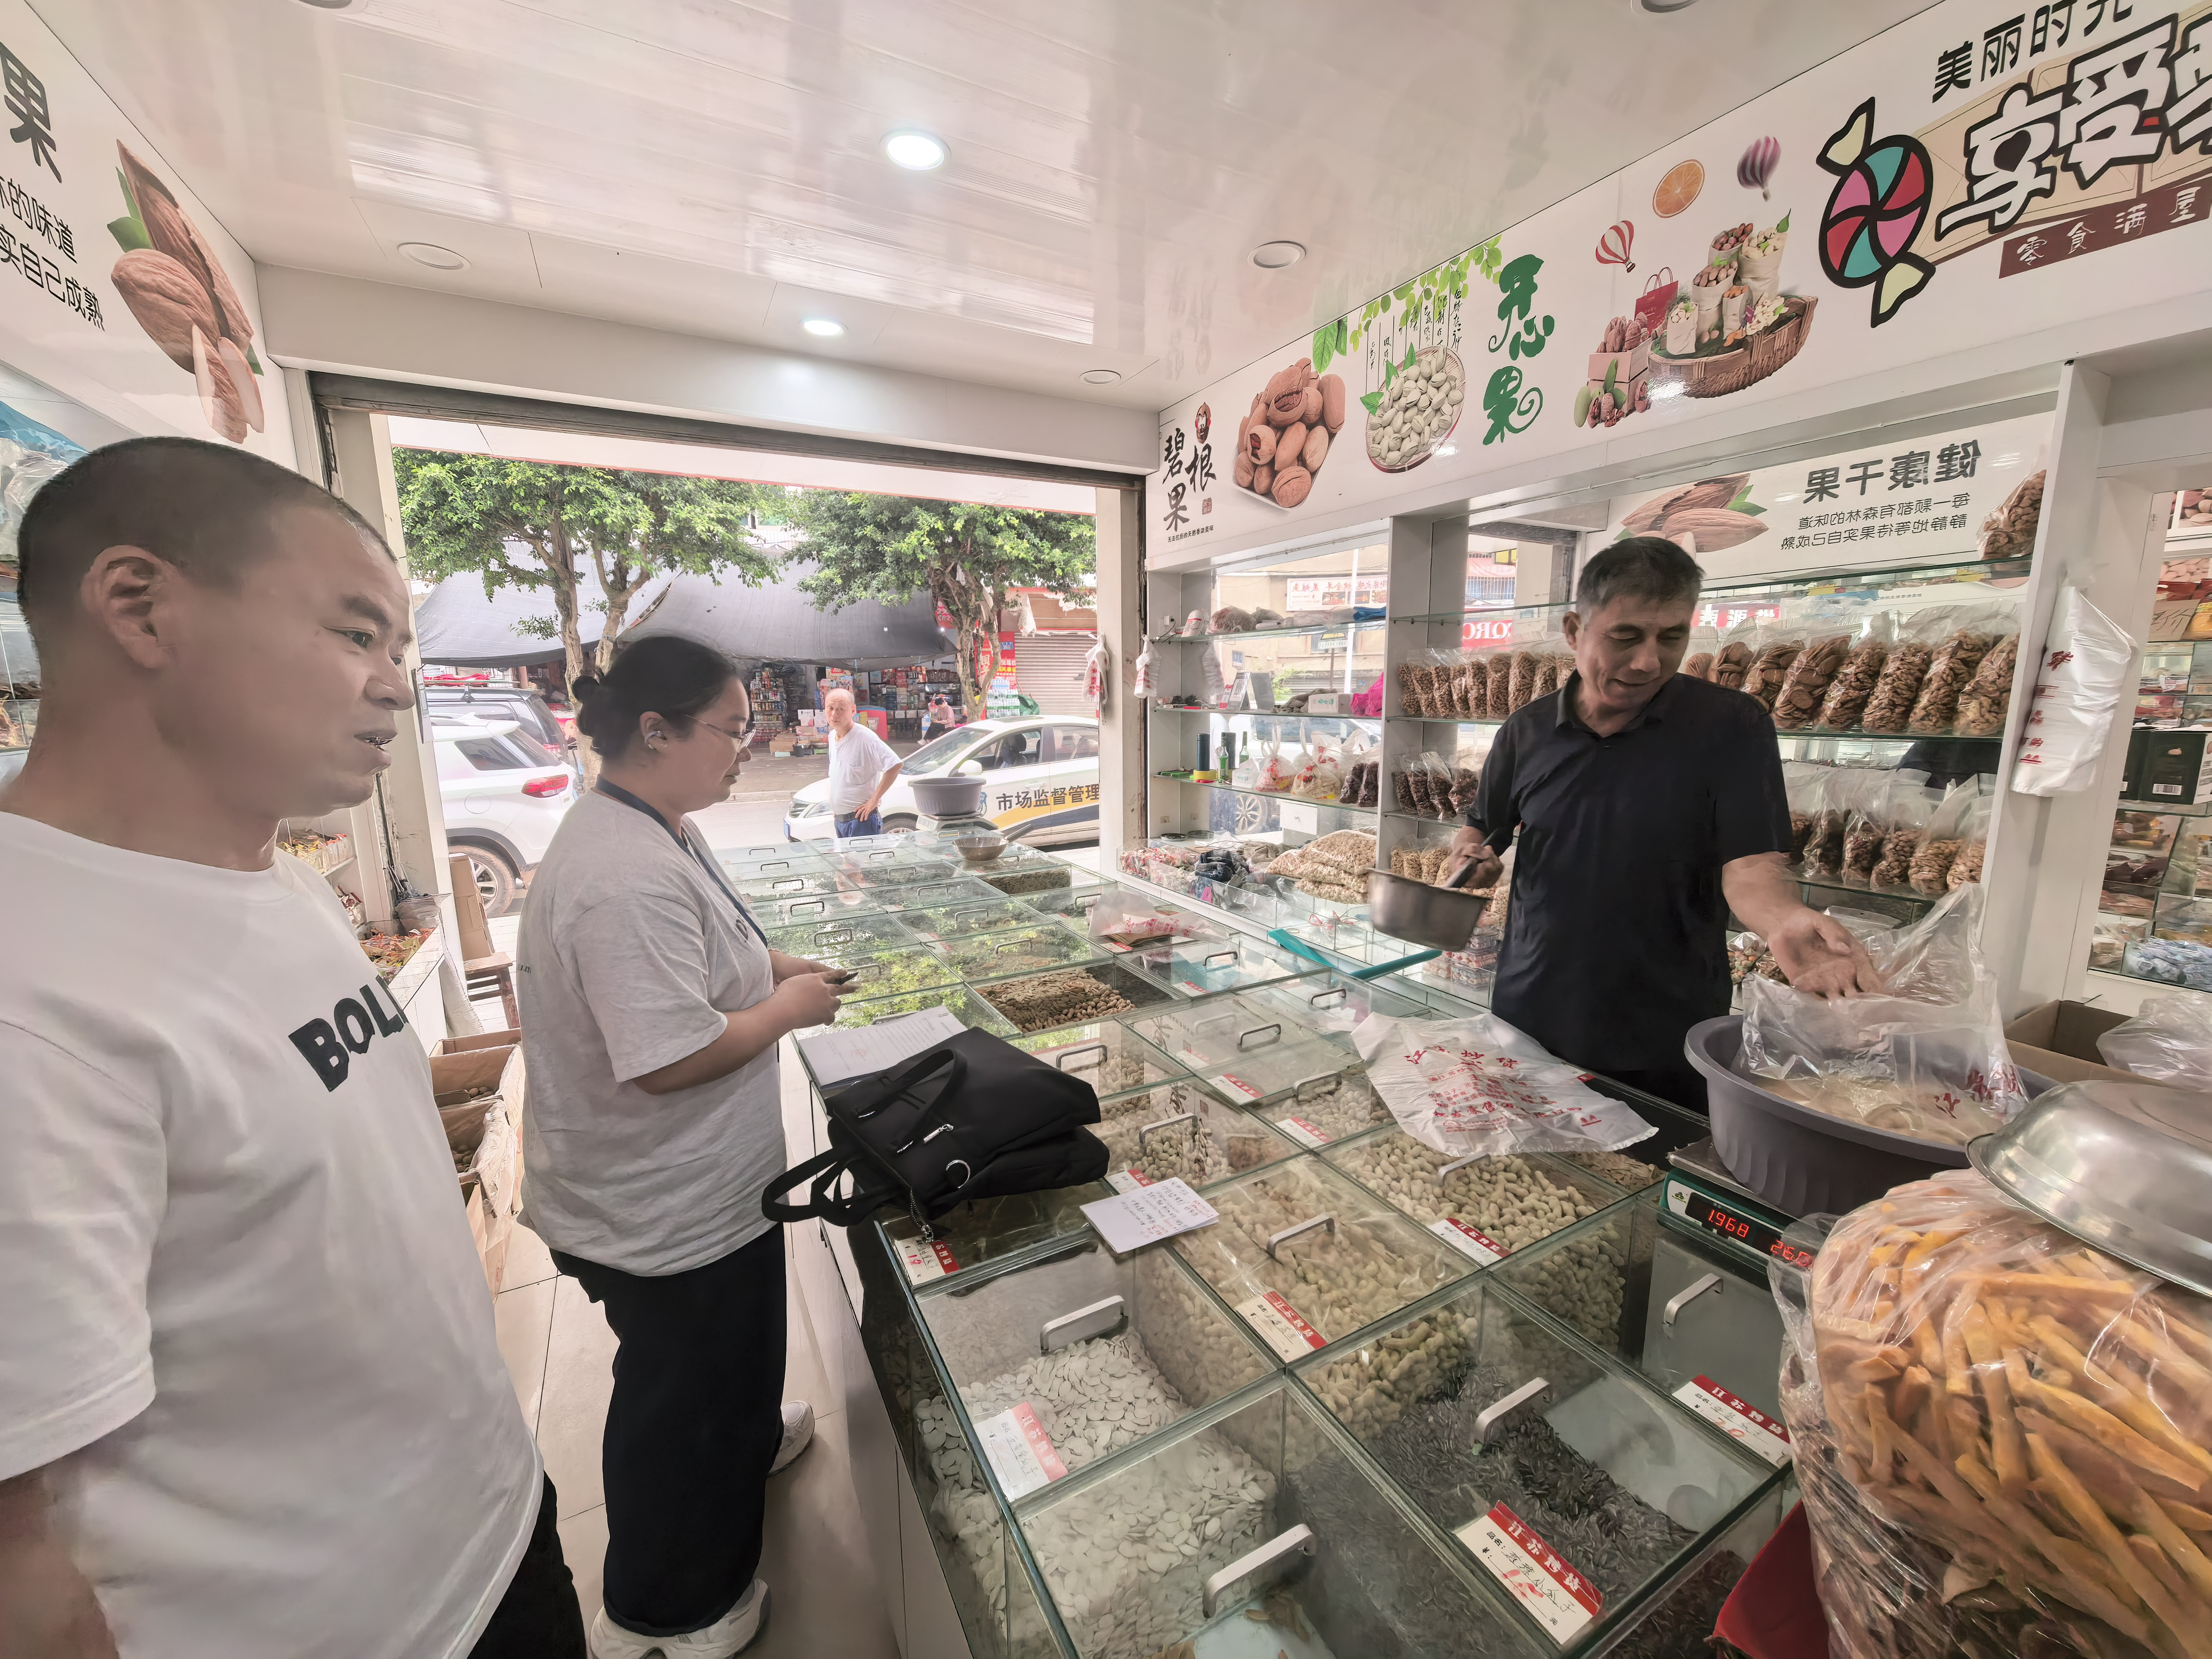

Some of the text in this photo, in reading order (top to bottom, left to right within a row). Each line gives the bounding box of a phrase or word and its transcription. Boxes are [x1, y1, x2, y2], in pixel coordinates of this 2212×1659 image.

[2017, 187, 2201, 265] 零食满屋
[1483, 254, 1555, 445] 开心果
[996, 784, 1099, 811] 市场监督管理
